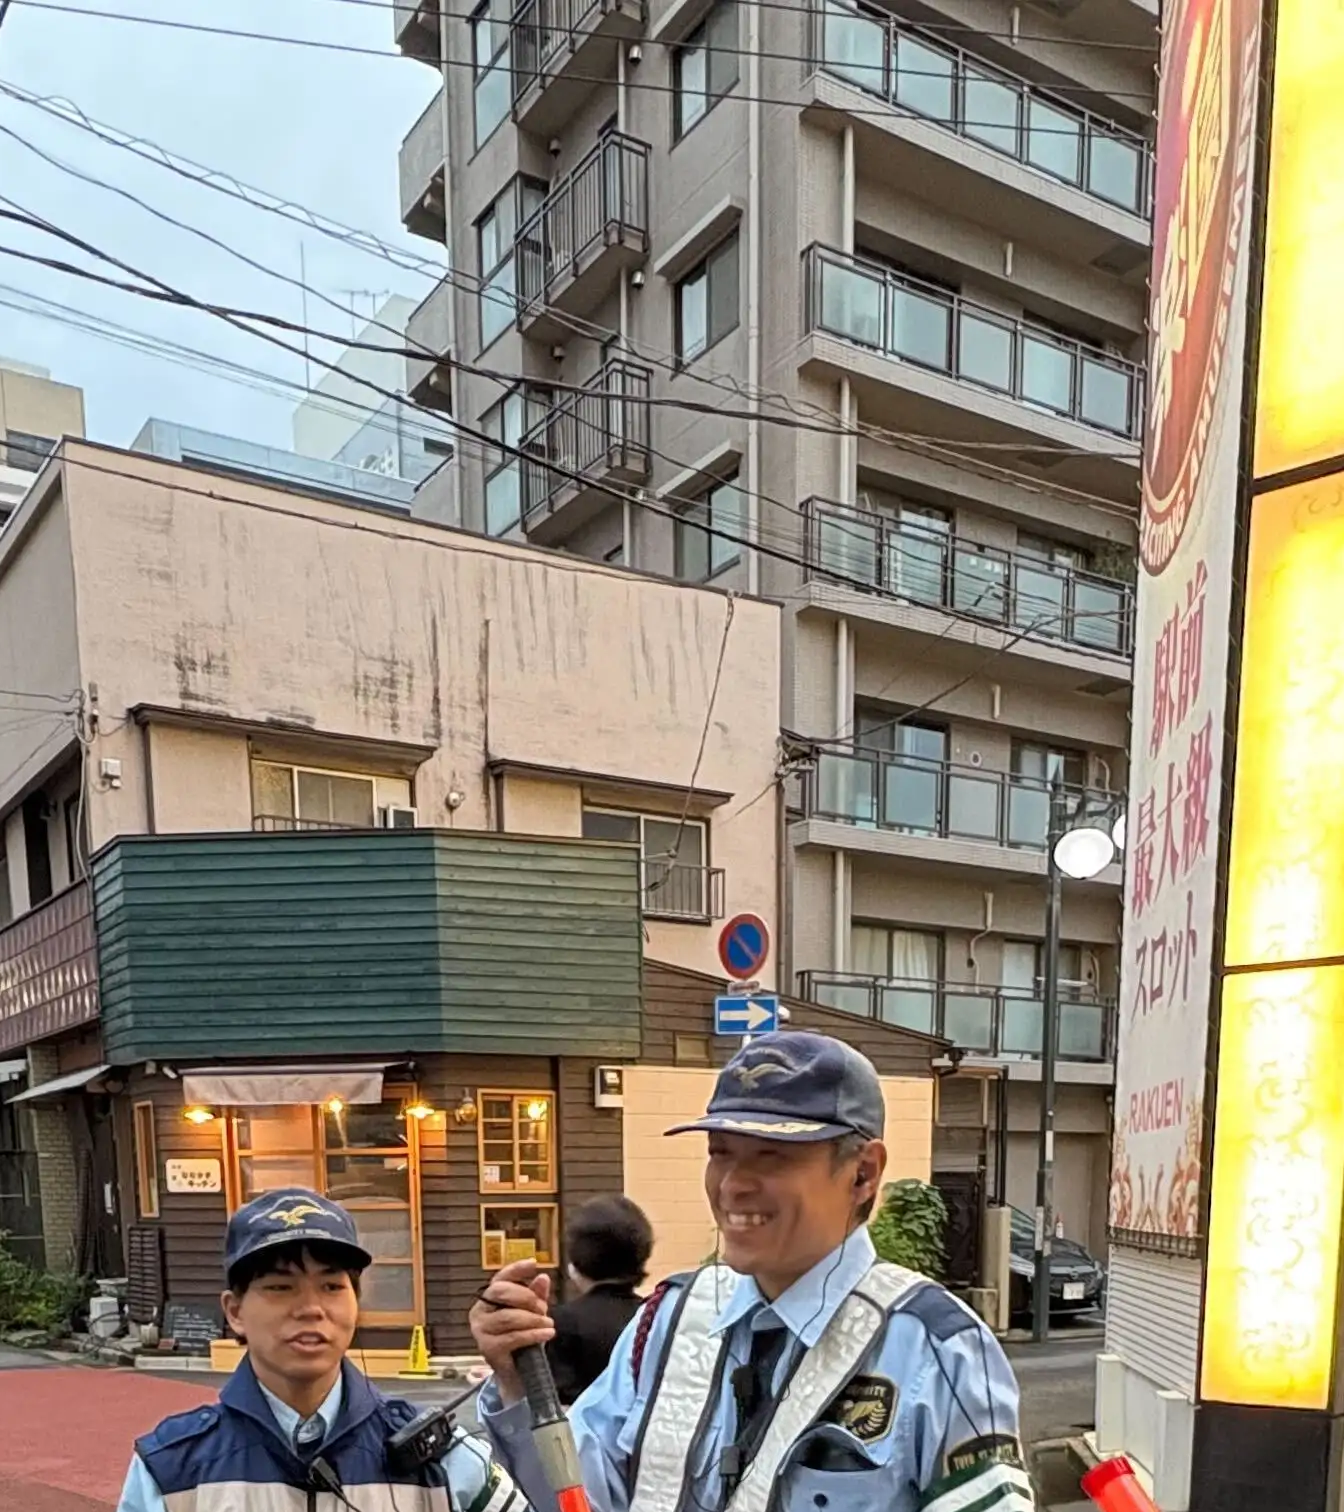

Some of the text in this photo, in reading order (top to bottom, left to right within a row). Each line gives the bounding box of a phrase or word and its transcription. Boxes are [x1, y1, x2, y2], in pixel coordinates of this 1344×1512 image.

[1140, 487, 1187, 566] EXCITING
[1149, 559, 1209, 760] 駅前
[1132, 710, 1214, 920] 最大級
[1131, 890, 1198, 1028] スロット
[1127, 1078, 1184, 1134] RAKUEN
